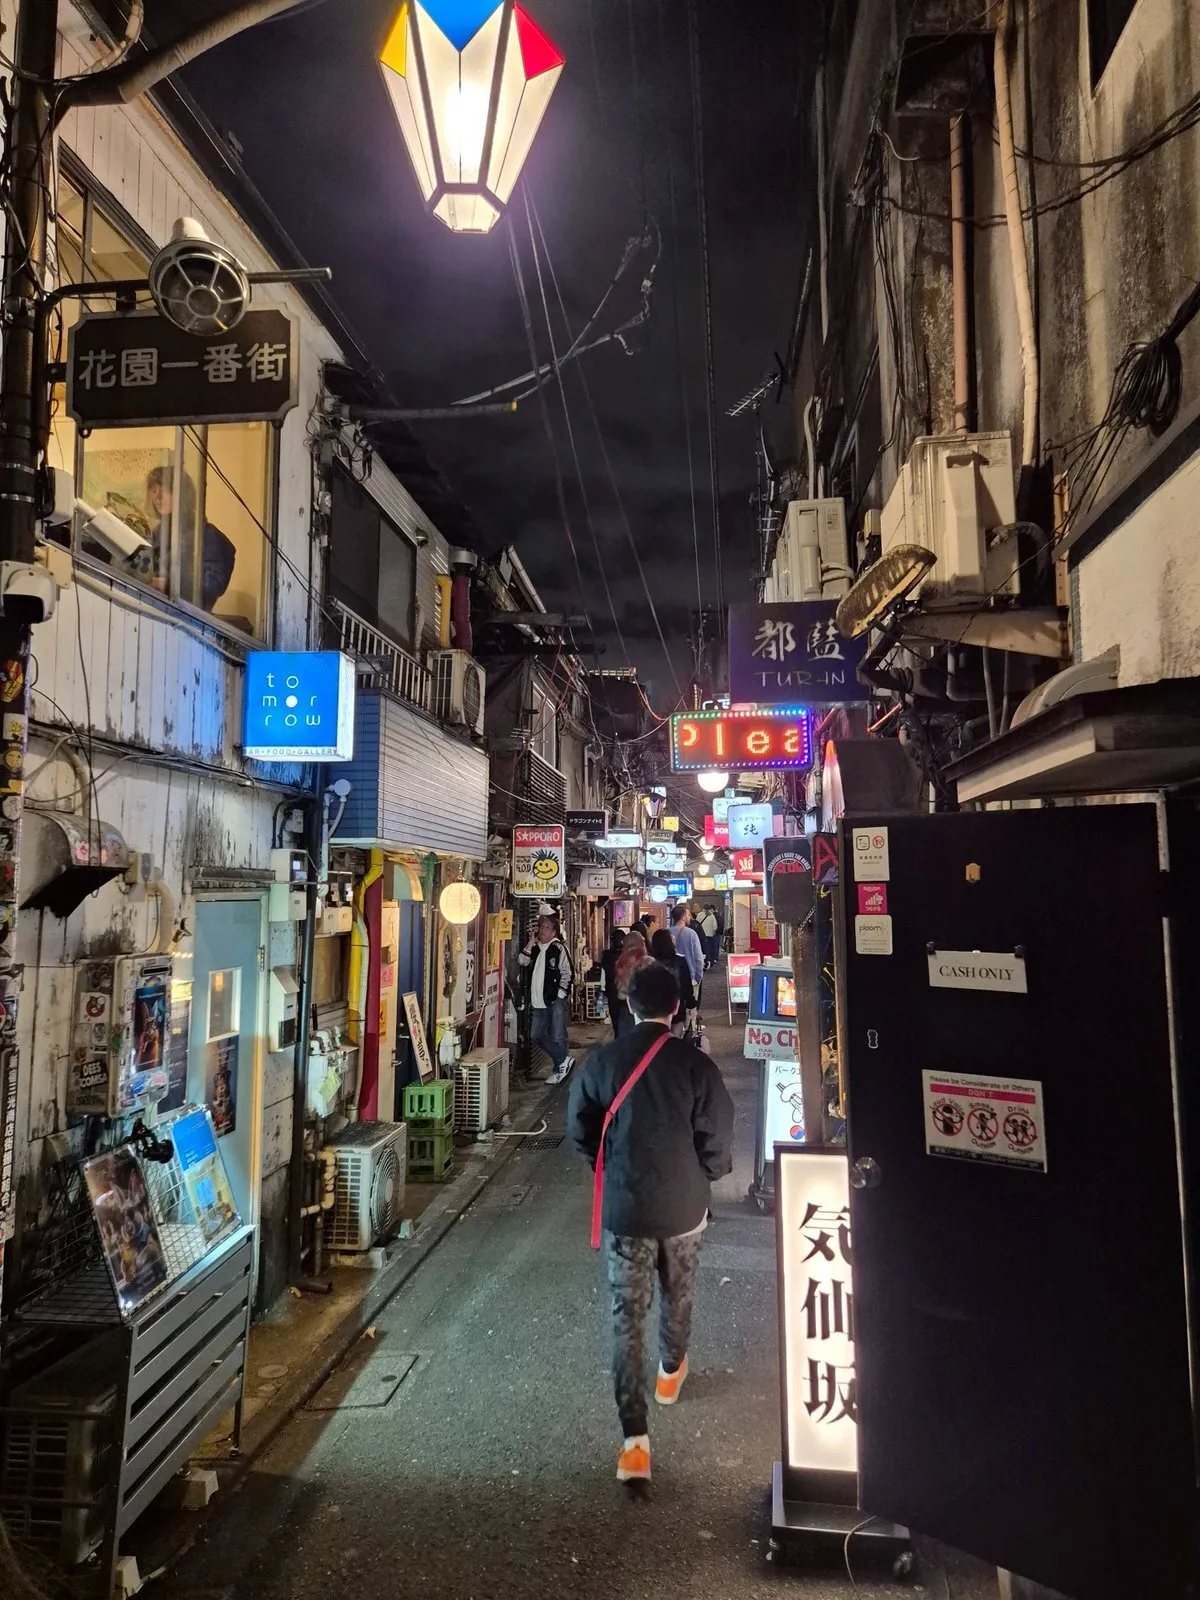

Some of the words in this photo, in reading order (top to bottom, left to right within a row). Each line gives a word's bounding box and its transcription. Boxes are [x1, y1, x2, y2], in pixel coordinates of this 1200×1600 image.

[79, 342, 287, 390] 花園一番街
[939, 965, 975, 979] CASH
[978, 967, 1014, 981] ONLY
[748, 1027, 773, 1046] No
[929, 1075, 949, 1083] Please
[961, 1079, 1001, 1089] Considerate
[1012, 1084, 1035, 1093] Others
[799, 1203, 859, 1424] 気仙坂
